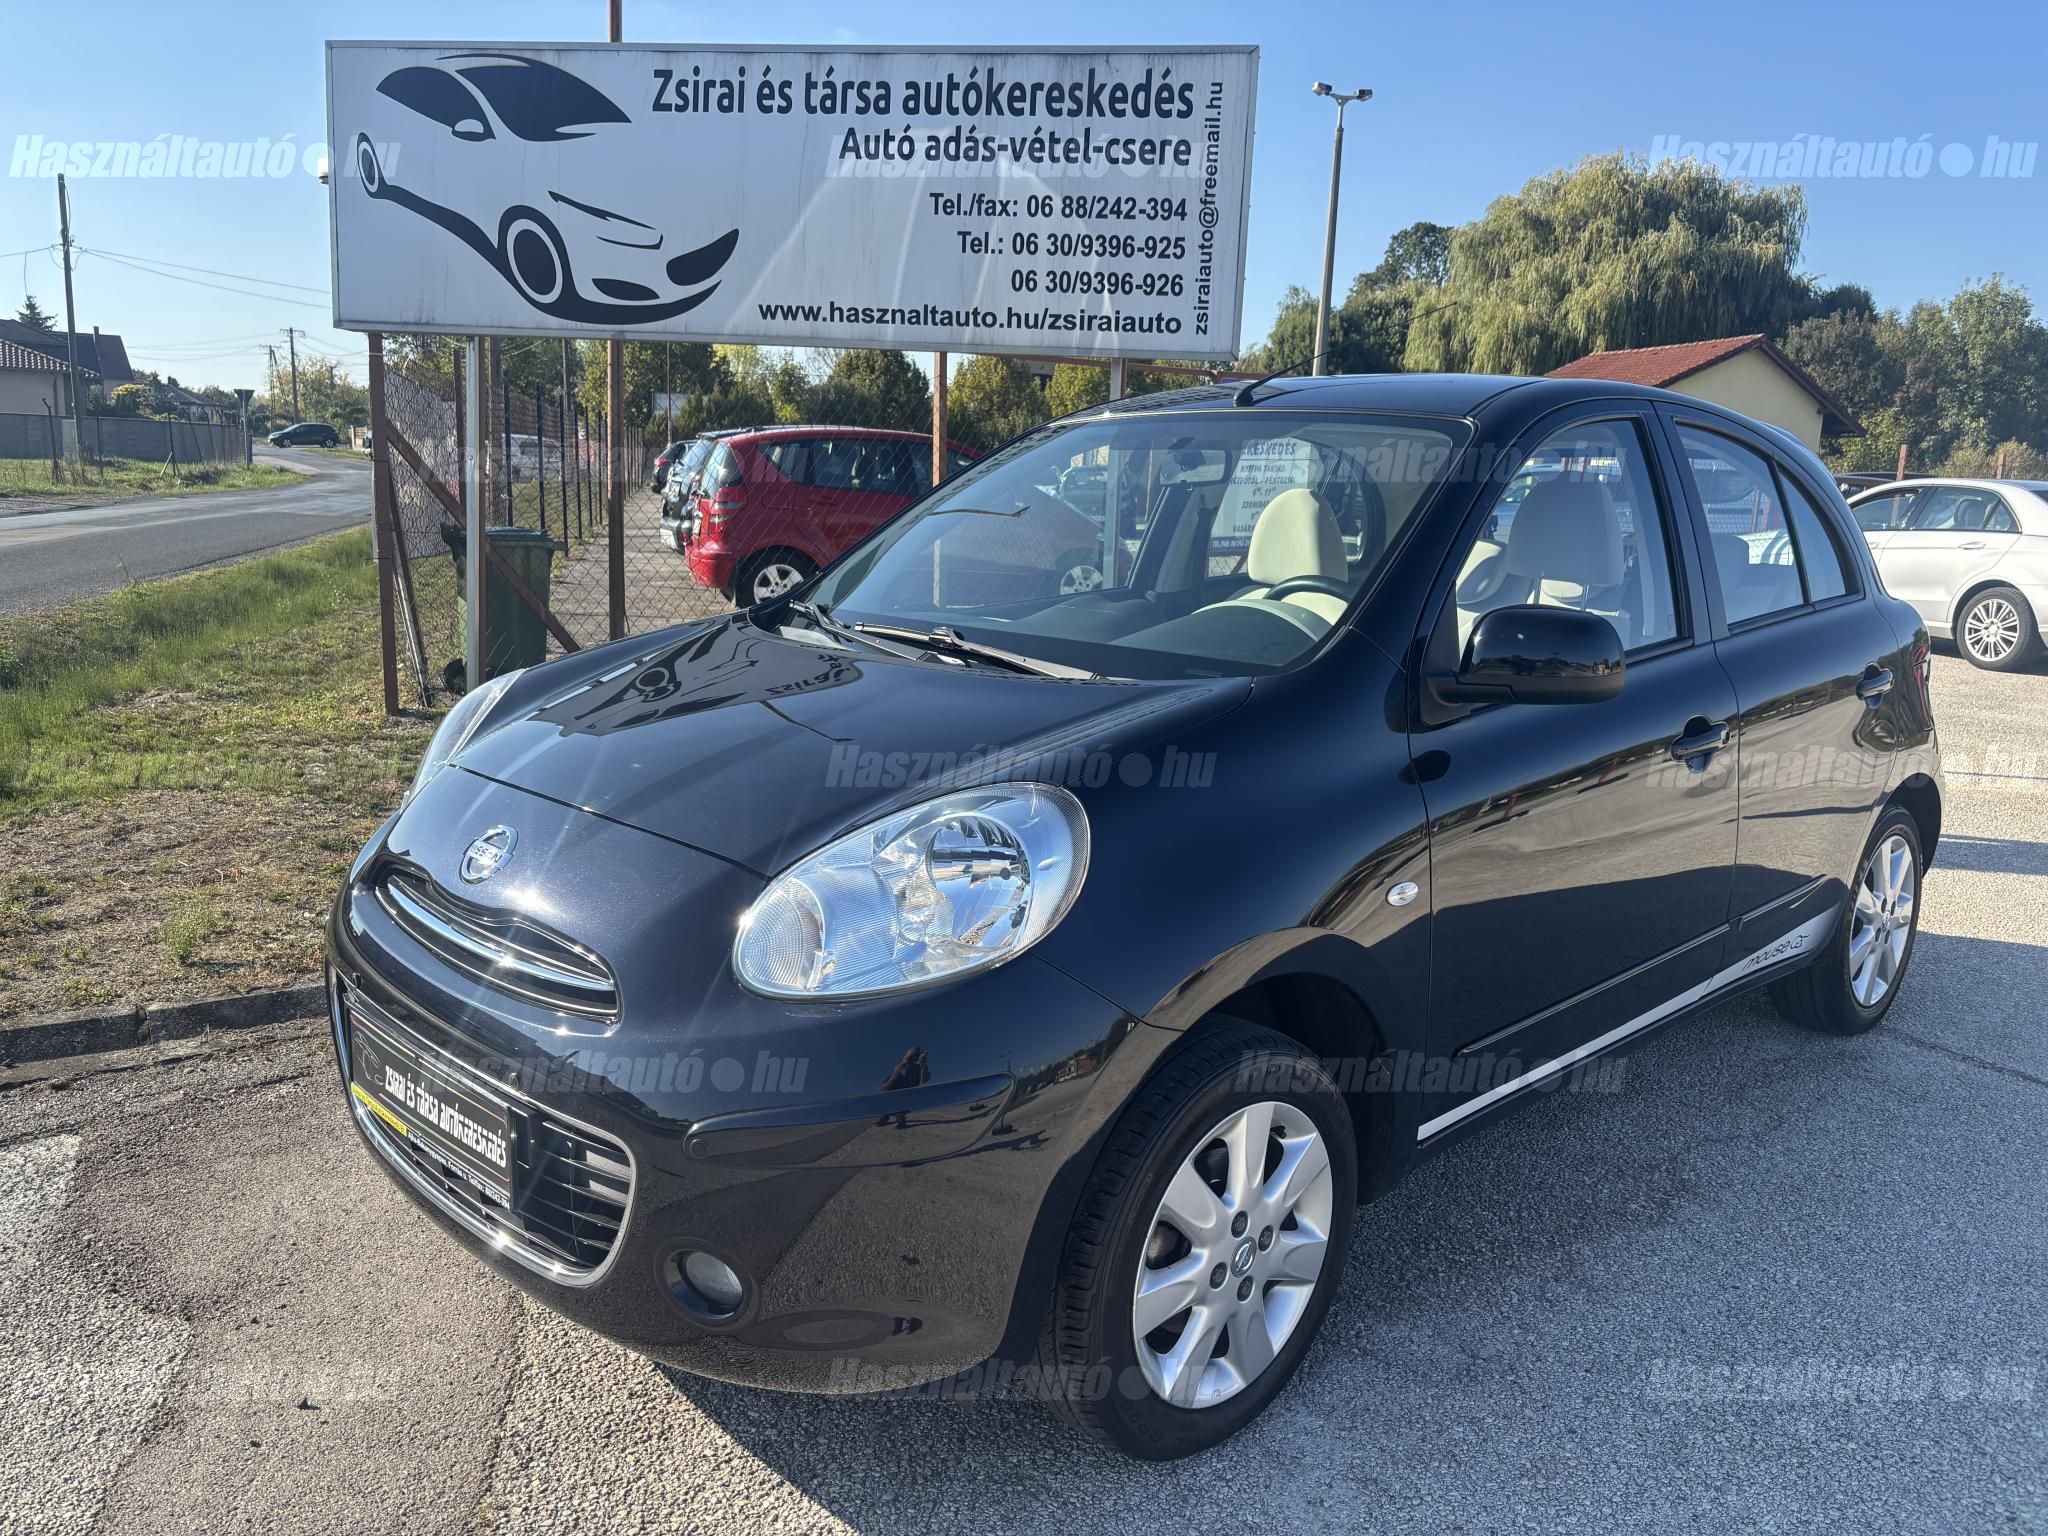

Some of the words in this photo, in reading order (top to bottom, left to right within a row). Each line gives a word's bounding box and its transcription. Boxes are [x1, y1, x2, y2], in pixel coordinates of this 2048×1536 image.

[652, 65, 746, 114] Zsirai
[756, 65, 793, 115] és
[804, 65, 892, 116] társa
[902, 65, 1194, 120] autókereskedés
[838, 123, 916, 161] Autó
[924, 124, 1192, 166] adás-vétel-csere
[929, 192, 1018, 219] Tel./fax:
[1026, 194, 1054, 218] 06
[1061, 195, 1188, 222] 88/242-394
[1195, 81, 1224, 336] zsiraiauto@freemail.hu
[956, 230, 1004, 255] Tel.:
[1012, 232, 1039, 256] 06
[1046, 232, 1186, 260] 30/9396-925
[1011, 269, 1038, 293] 06
[1045, 270, 1184, 297] 30/9396-926
[758, 300, 1182, 334] www.hasznaltauto.hu/zsiraiauto
